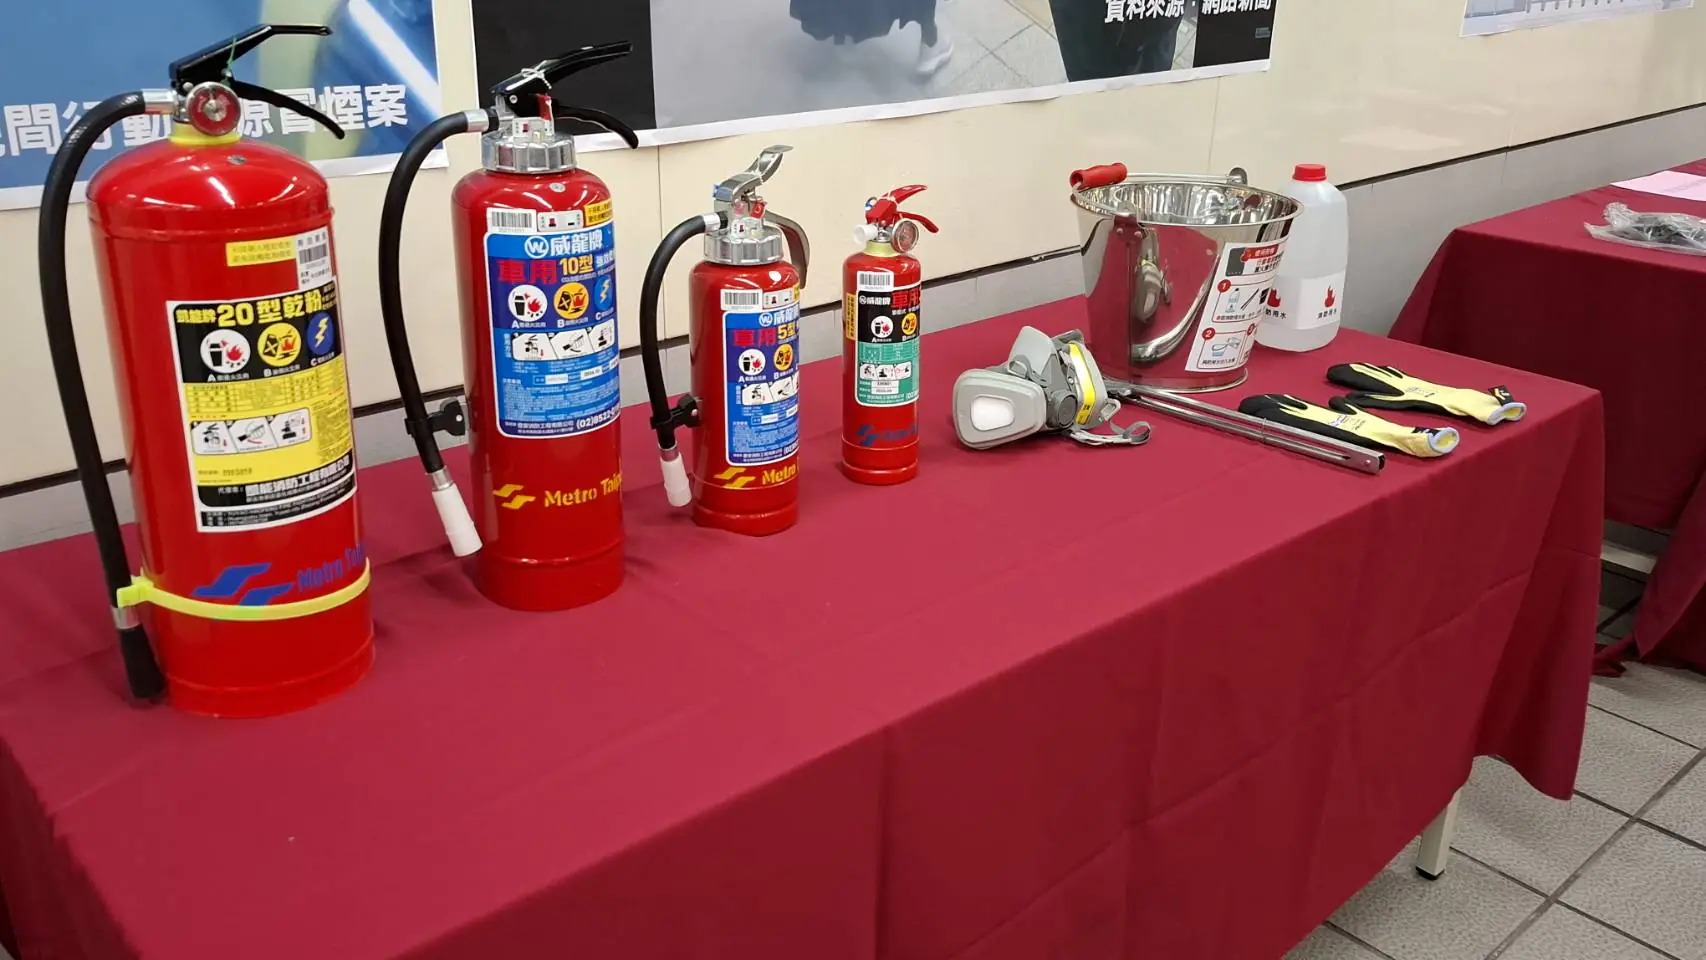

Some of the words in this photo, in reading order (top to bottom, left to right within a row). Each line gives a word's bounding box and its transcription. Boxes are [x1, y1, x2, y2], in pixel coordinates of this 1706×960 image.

[550, 229, 603, 257] 威龍牌
[560, 254, 595, 275] 10型
[544, 488, 598, 508] Metro
